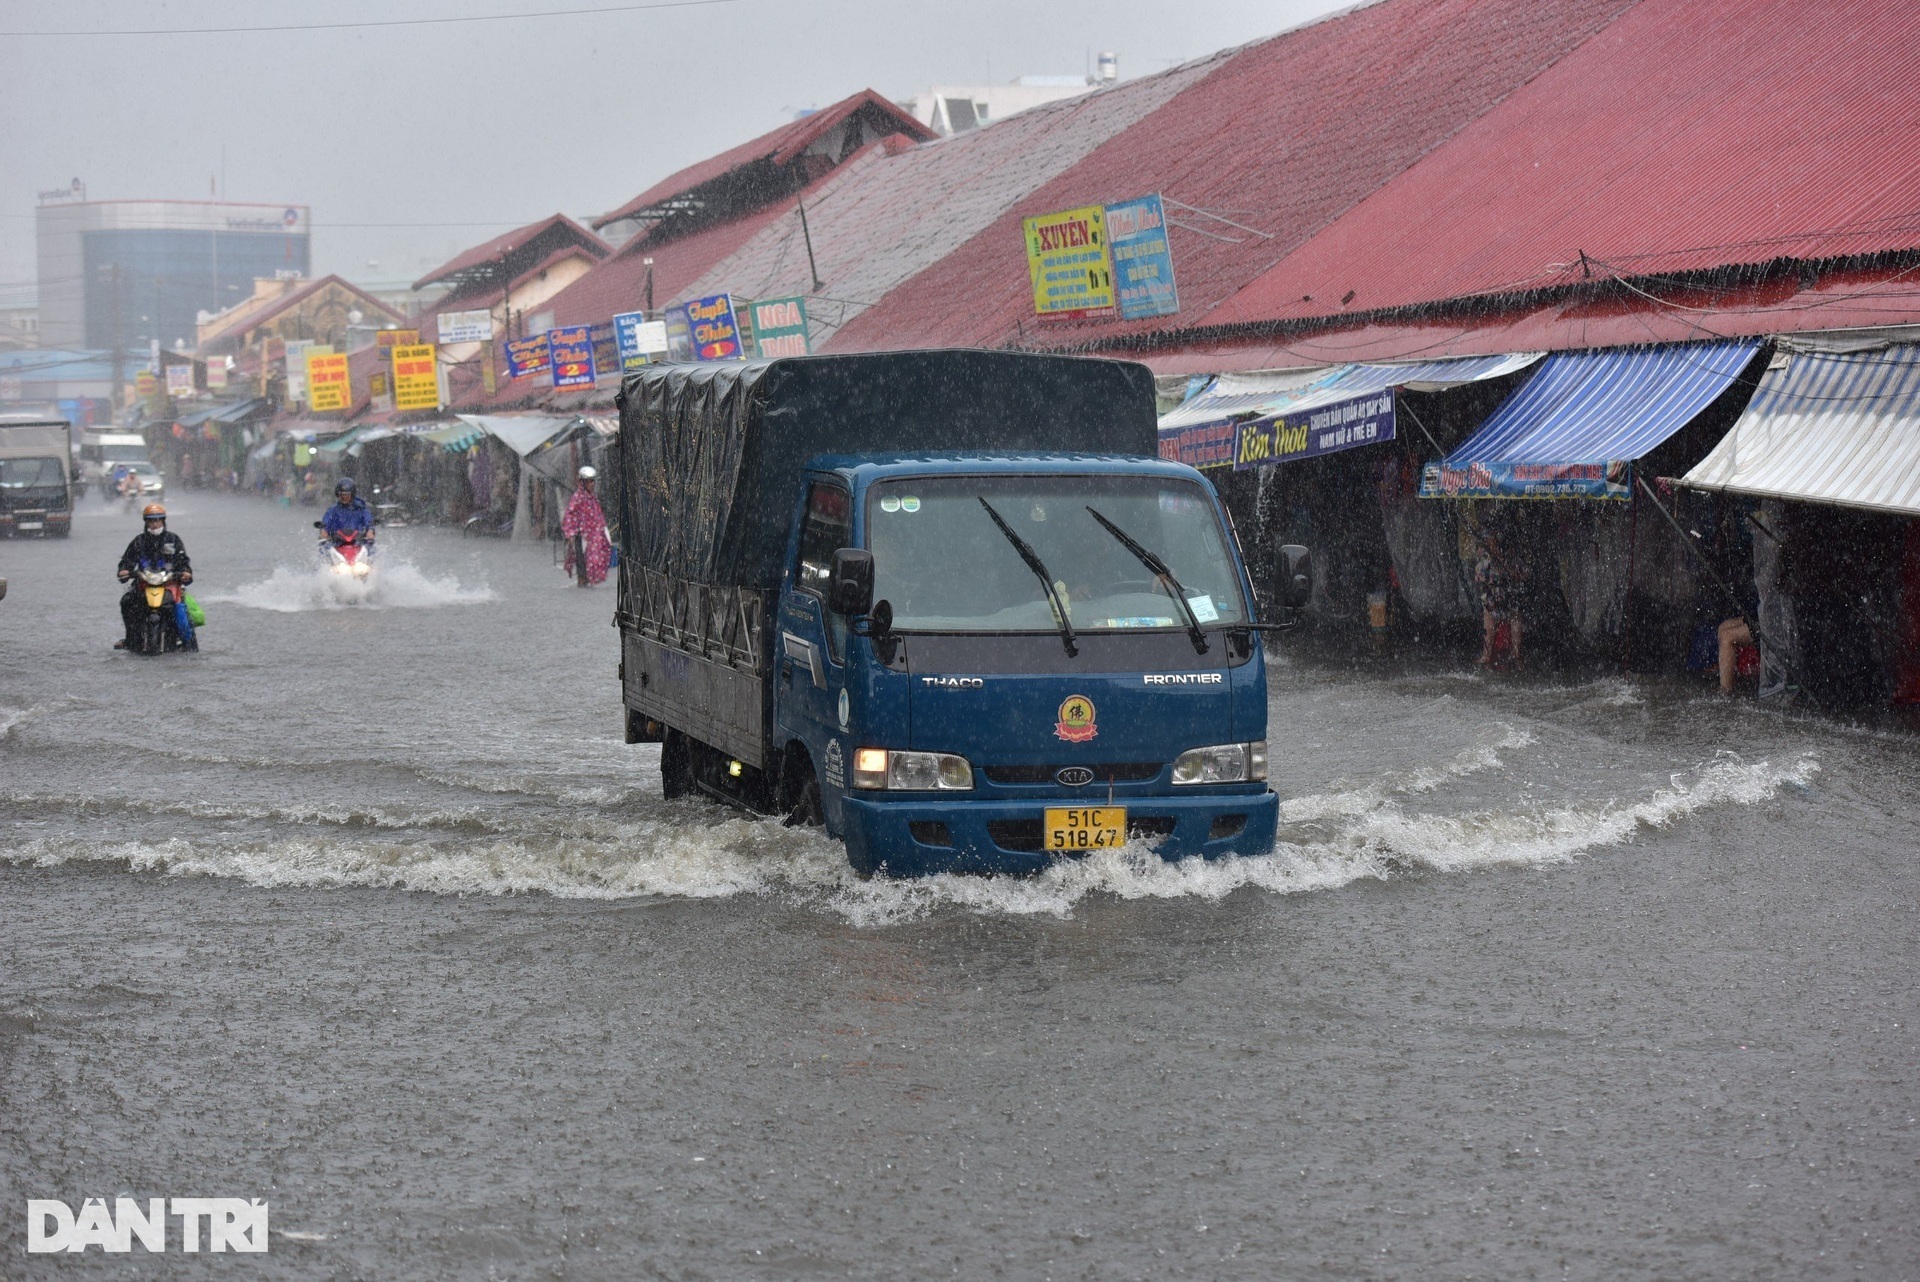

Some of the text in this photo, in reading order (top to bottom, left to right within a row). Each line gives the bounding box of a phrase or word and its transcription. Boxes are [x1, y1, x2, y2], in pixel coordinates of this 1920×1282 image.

[1038, 216, 1089, 251] XUYÊN
[757, 302, 803, 330] NGA
[712, 342, 723, 357] 1
[759, 333, 808, 358] TRANG
[526, 358, 540, 369] 2
[566, 364, 580, 376] 2
[1239, 426, 1270, 463] Kim
[1274, 419, 1308, 457] Thoa
[1320, 432, 1335, 449] NAM
[1346, 428, 1352, 443] &
[1366, 422, 1377, 438] EM
[1440, 463, 1468, 495] Ngọc
[922, 677, 984, 688] THACO
[1143, 673, 1222, 687] FRONTIER
[1069, 704, 1084, 719] 佛
[1063, 771, 1088, 782] KIA
[1068, 810, 1102, 828] 51C
[1054, 829, 1117, 848] 518.47
